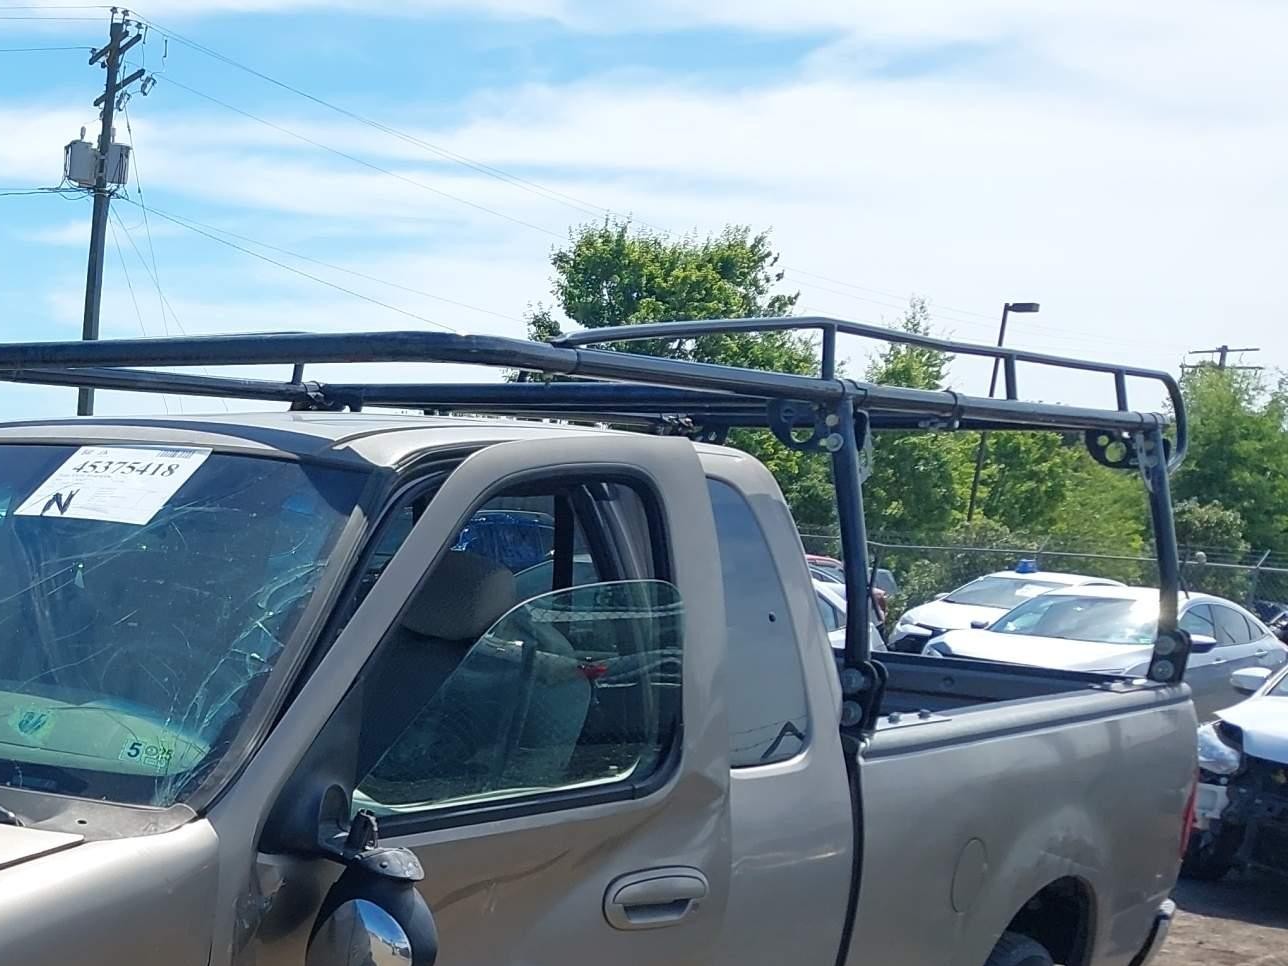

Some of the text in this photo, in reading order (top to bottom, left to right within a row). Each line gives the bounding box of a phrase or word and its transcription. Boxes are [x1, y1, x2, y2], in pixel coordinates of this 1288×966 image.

[72, 459, 180, 478] 45375418
[39, 488, 80, 516] N
[127, 742, 142, 758] 5
